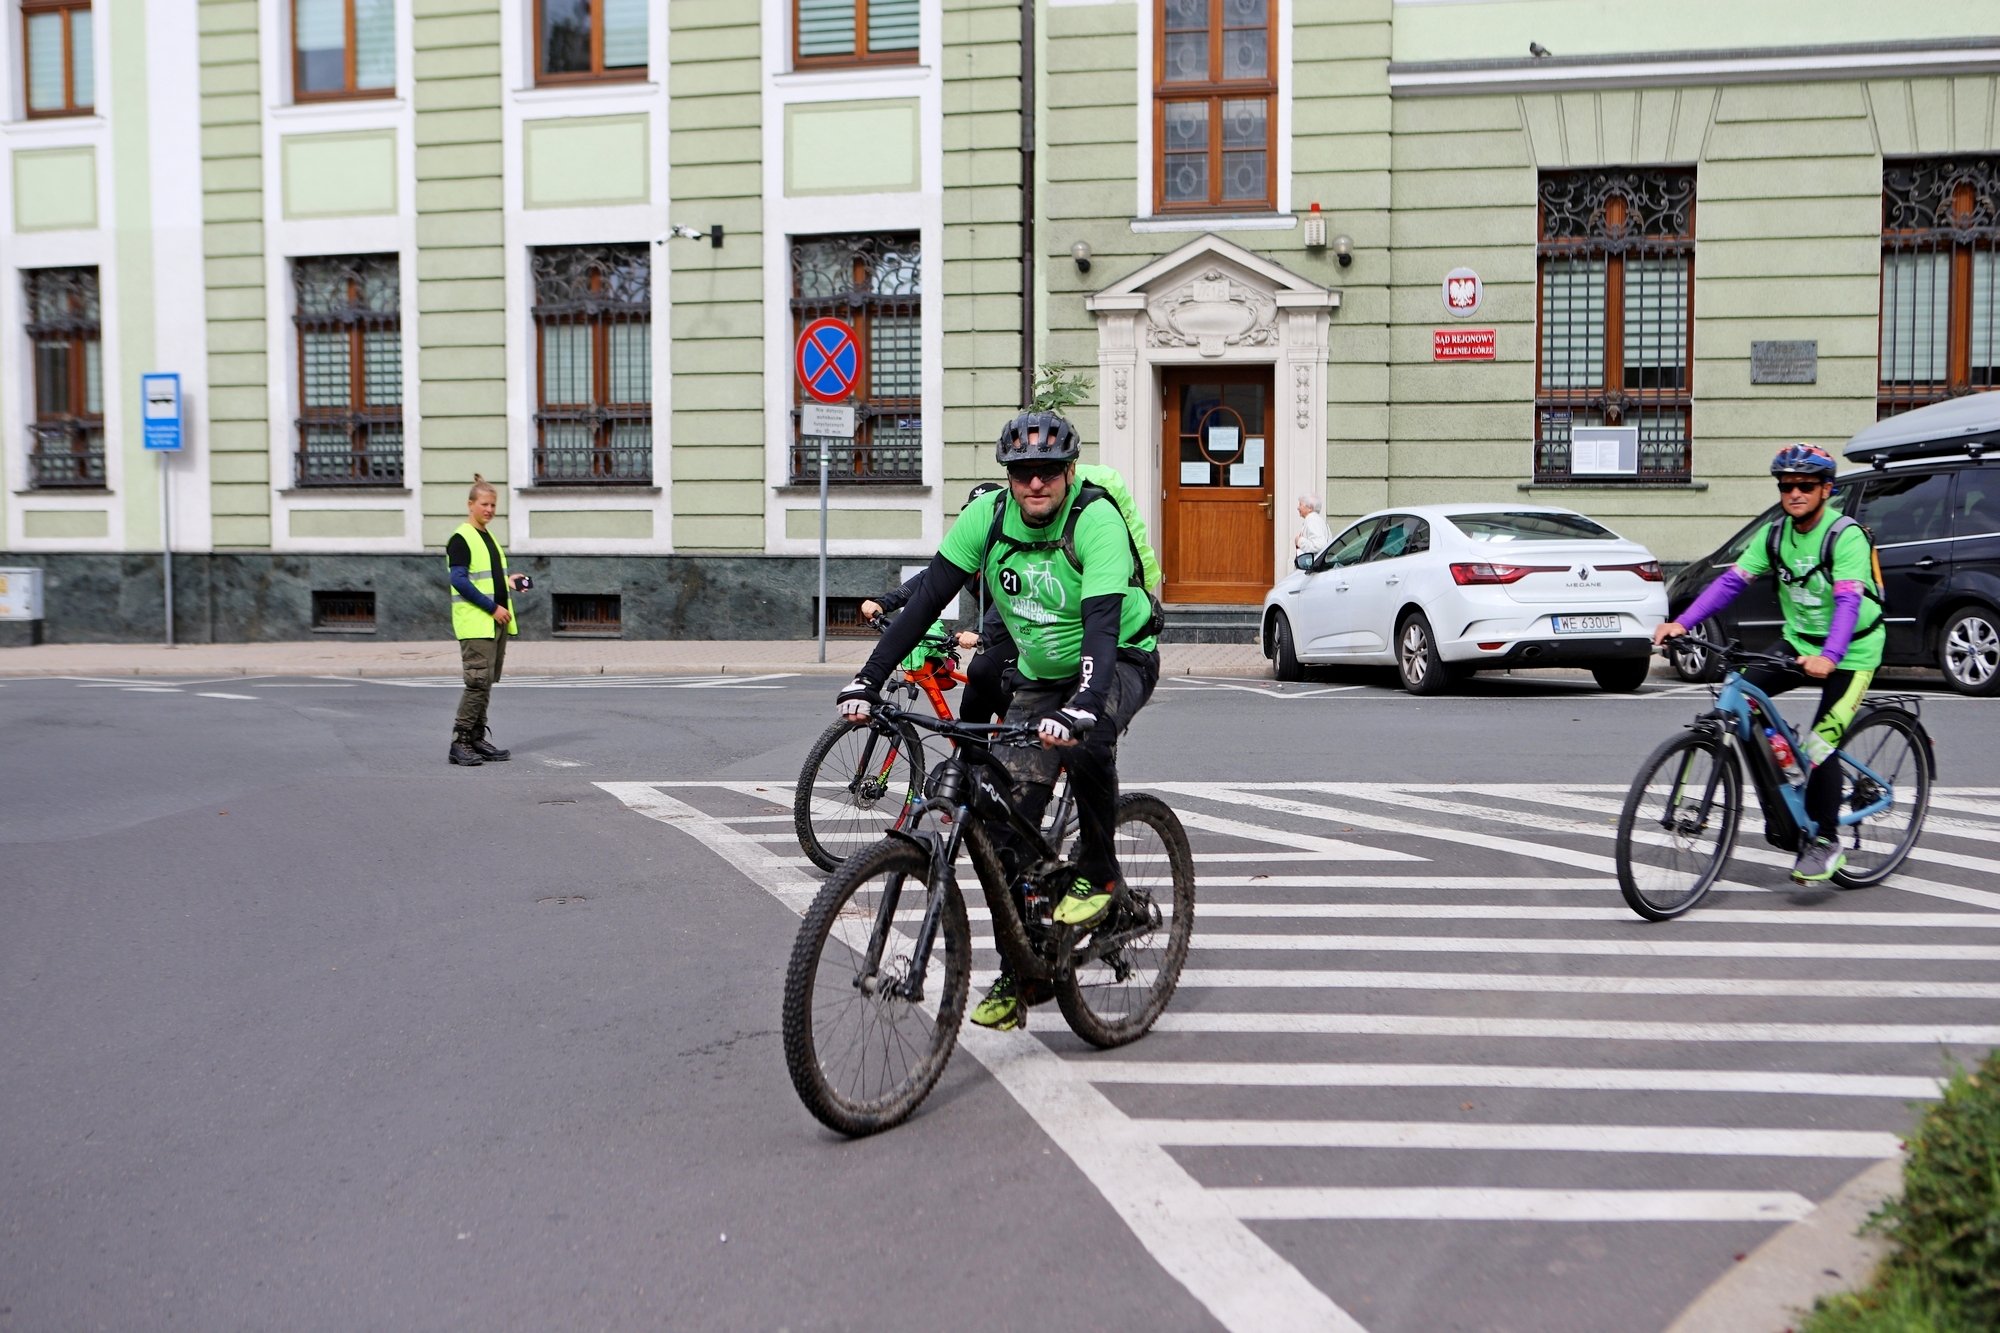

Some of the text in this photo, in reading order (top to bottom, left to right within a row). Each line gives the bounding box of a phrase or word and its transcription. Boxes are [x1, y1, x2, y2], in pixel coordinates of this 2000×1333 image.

[1435, 334, 1493, 345] SĄD REJONOWY
[1443, 346, 1471, 354] JELENIEJ
[1472, 346, 1494, 354] GÓRZE
[1003, 571, 1017, 592] 21
[1561, 616, 1616, 629] WE 630UF
